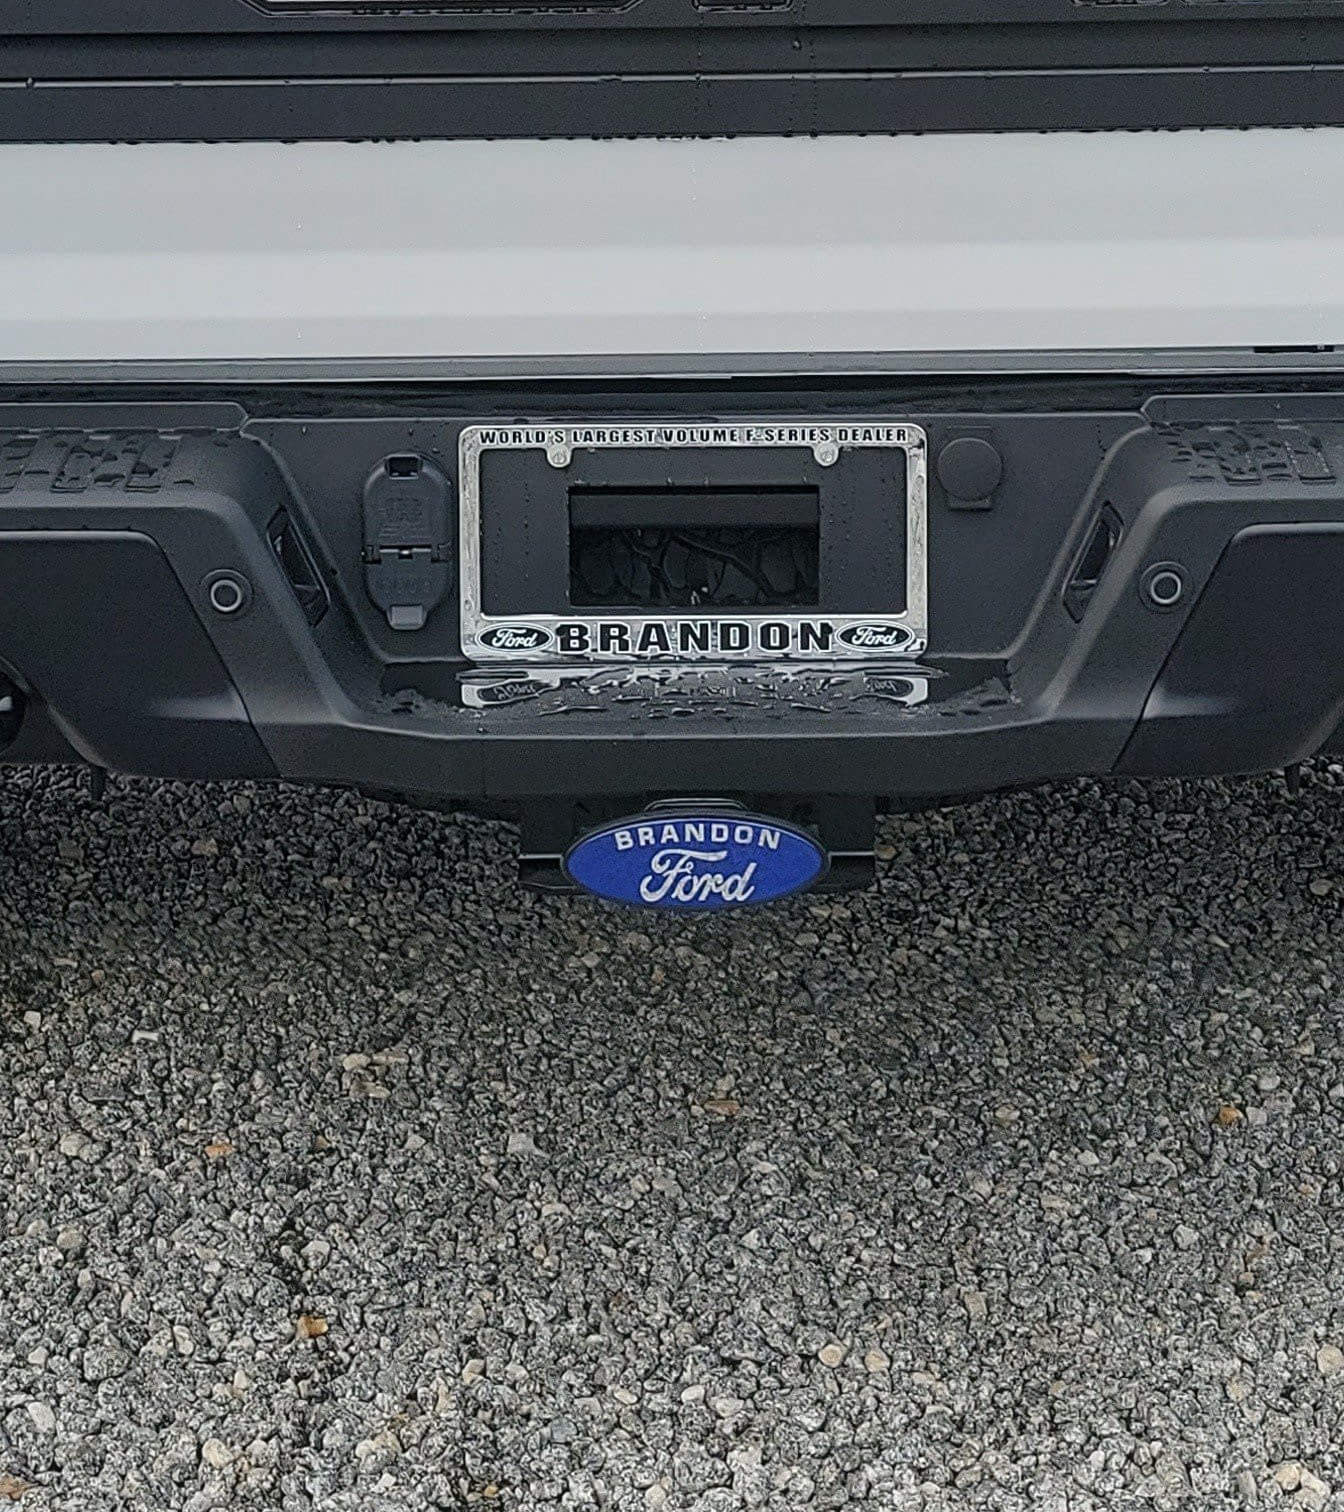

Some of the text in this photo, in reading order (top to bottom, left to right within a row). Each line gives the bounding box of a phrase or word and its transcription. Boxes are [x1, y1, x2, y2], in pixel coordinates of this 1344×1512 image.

[479, 428, 907, 444] WORLD'S LARGEST VOLUME F-SERIES DEALER
[491, 621, 898, 653] Ford BRANDON Ford
[614, 822, 781, 851] BRANDON
[639, 848, 757, 902] Ford
